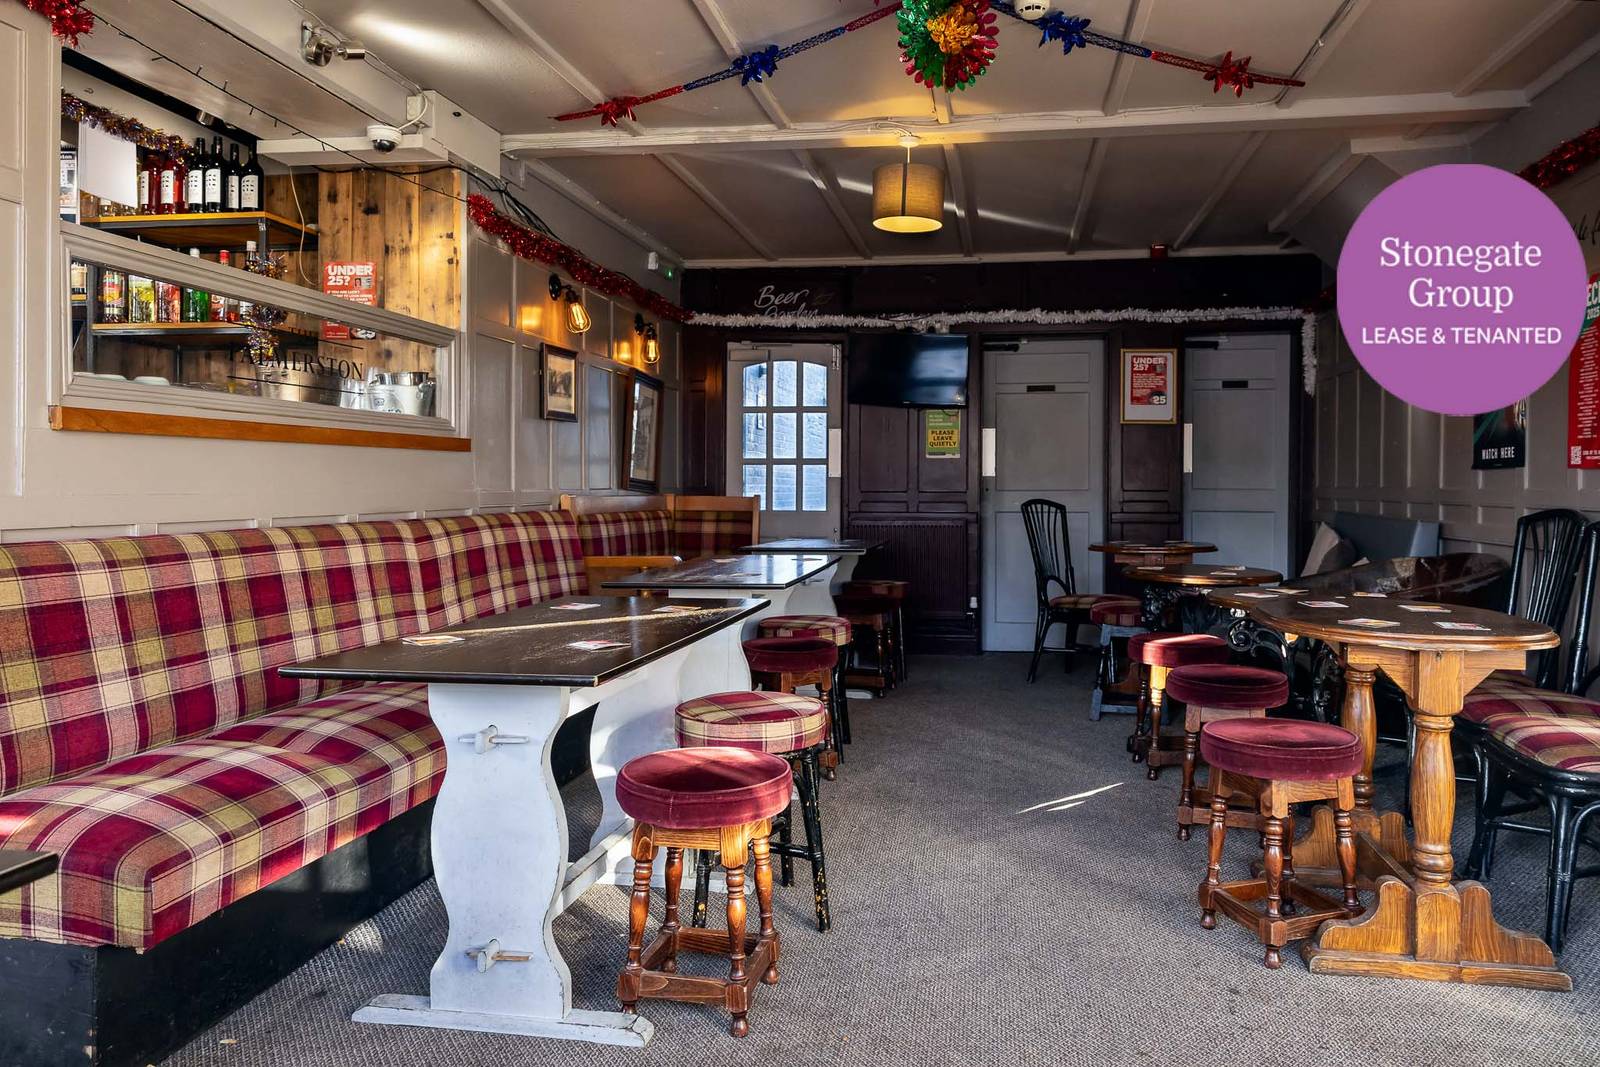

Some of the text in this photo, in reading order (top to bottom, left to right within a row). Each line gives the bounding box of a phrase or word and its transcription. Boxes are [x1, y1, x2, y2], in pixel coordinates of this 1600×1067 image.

[327, 265, 373, 276] UNDER
[327, 276, 350, 286] 25?
[754, 284, 809, 309] Beer
[1153, 395, 1166, 404] 25
[1482, 446, 1515, 460] WATCH HERE
